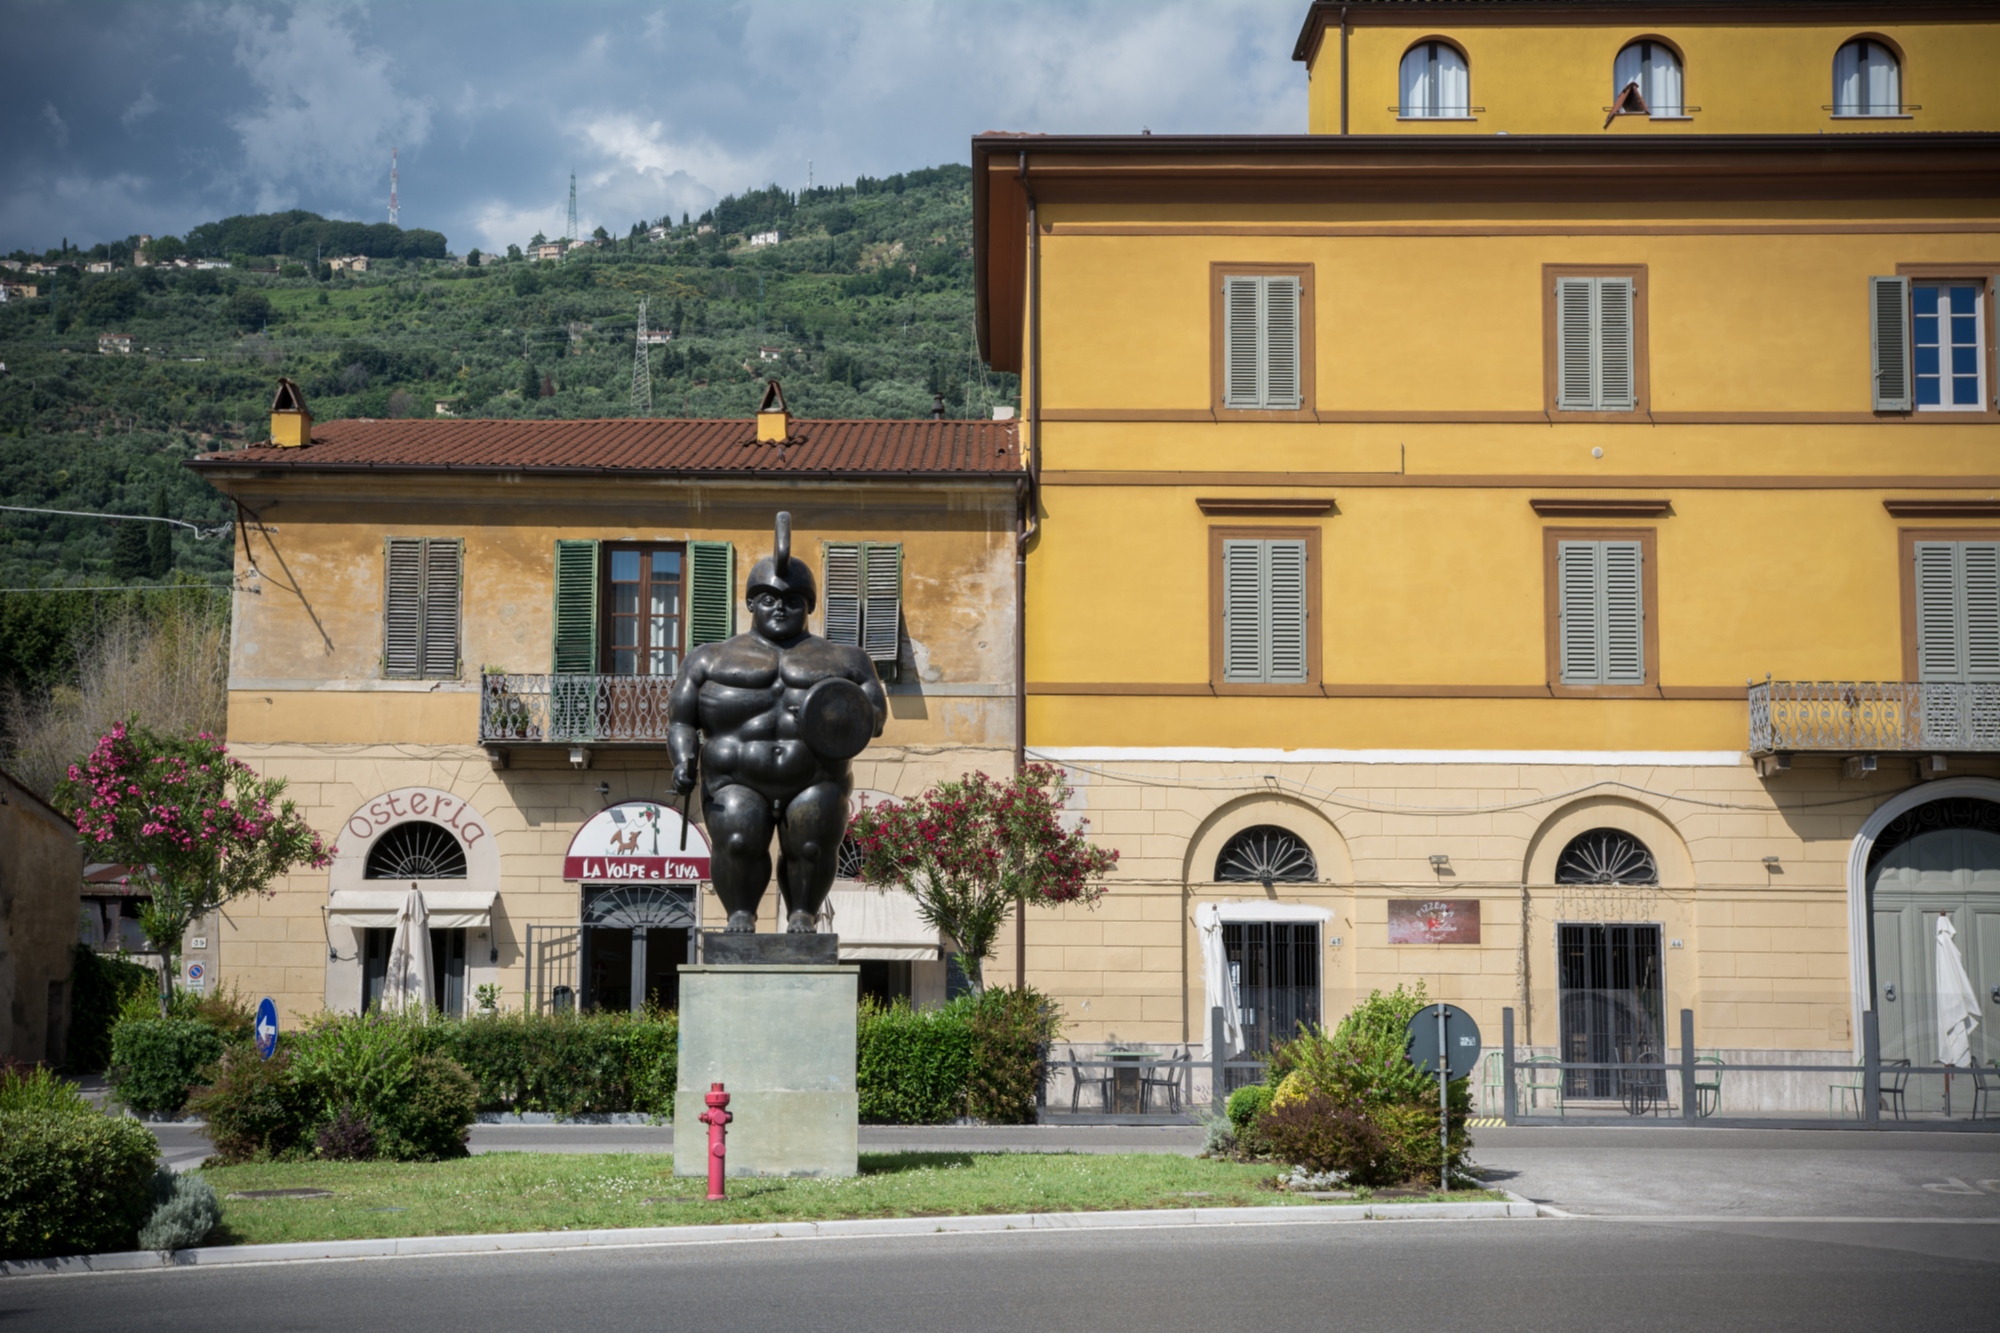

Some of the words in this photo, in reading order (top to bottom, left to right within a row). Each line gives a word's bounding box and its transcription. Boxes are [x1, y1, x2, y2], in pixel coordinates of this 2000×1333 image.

[349, 793, 485, 850] Osteria
[583, 858, 601, 878] LA
[605, 857, 646, 878] VOLPE
[665, 858, 700, 879] L'UVA
